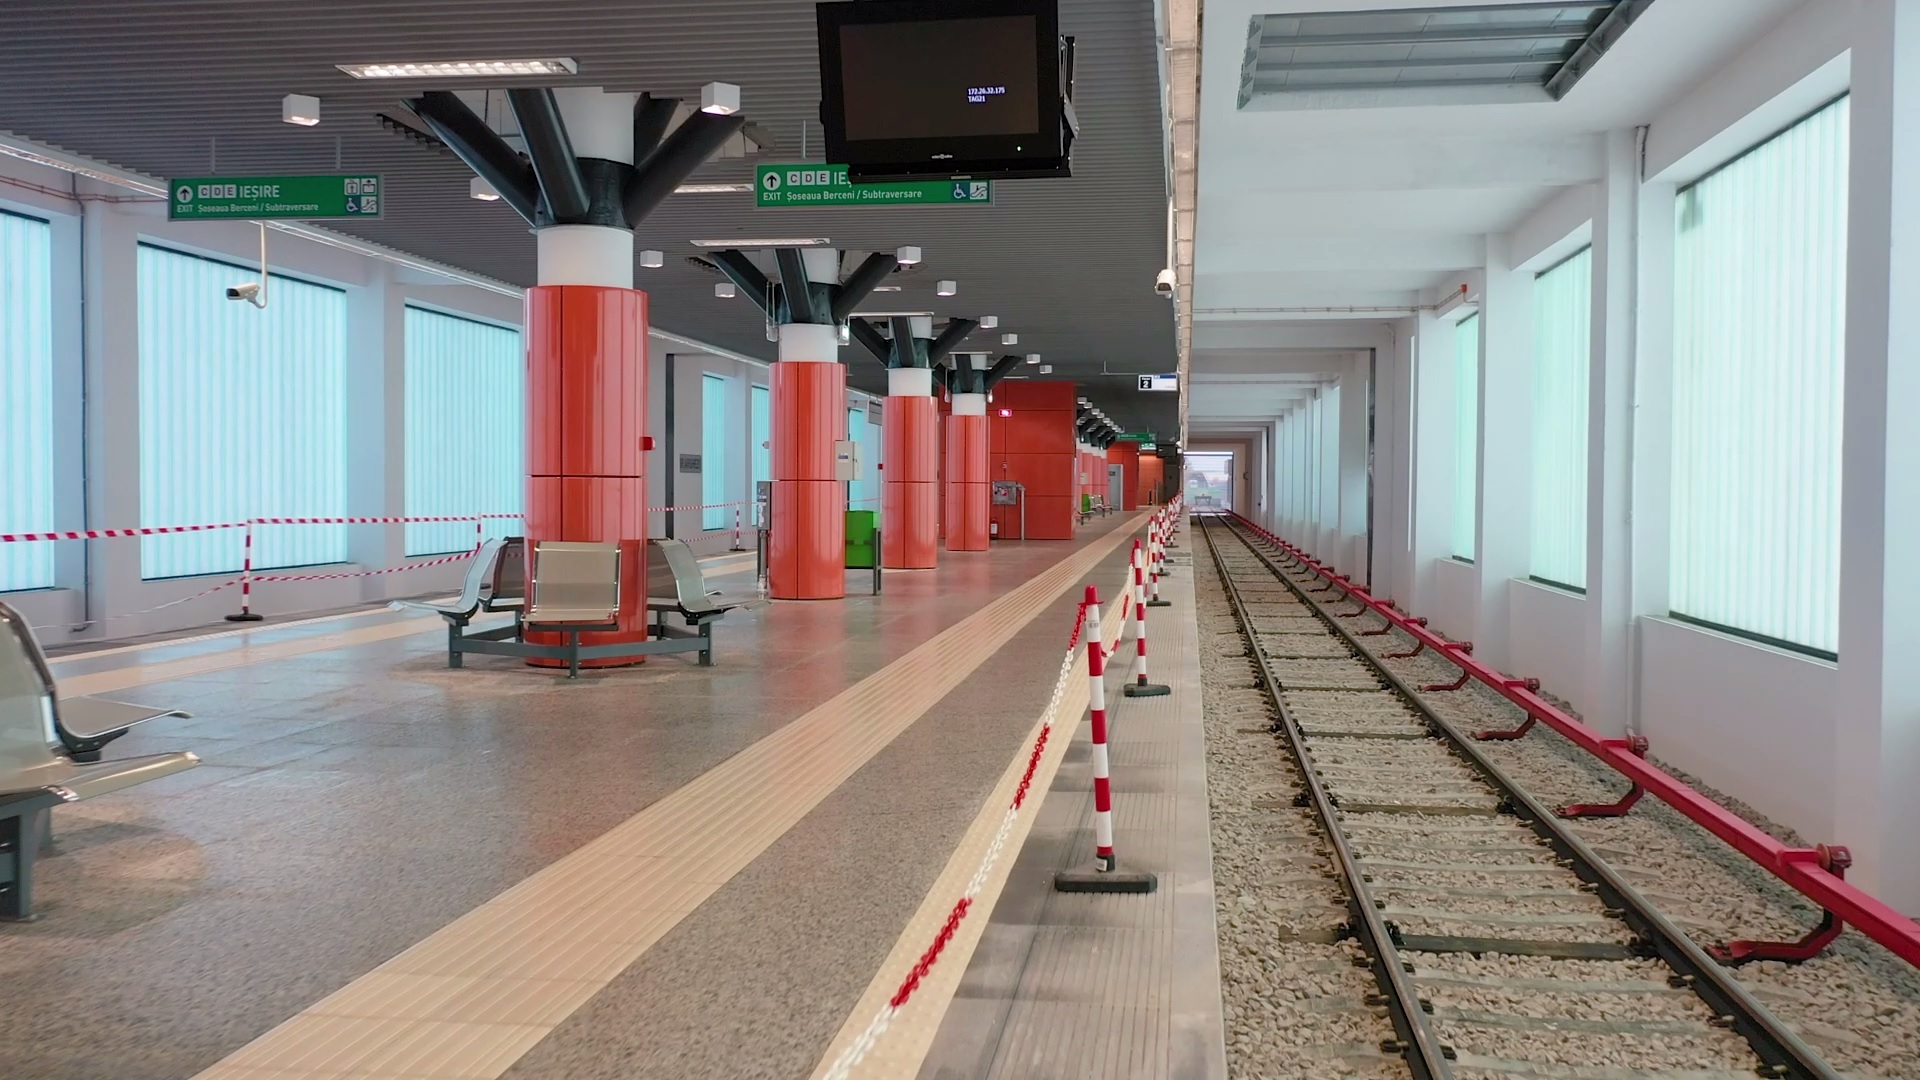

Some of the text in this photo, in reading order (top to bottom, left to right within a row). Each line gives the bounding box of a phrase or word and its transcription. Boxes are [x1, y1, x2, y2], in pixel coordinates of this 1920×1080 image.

[790, 172, 852, 188] C D E IE
[200, 185, 280, 201] C D E IEȘIRE
[763, 192, 781, 201] EXIT
[823, 190, 855, 200] Berceni
[862, 189, 923, 199] Subtraversare
[177, 204, 194, 213] EXIT
[230, 203, 259, 213] Berceni
[265, 203, 319, 212] Subtraversare
[1143, 380, 1149, 388] 2
